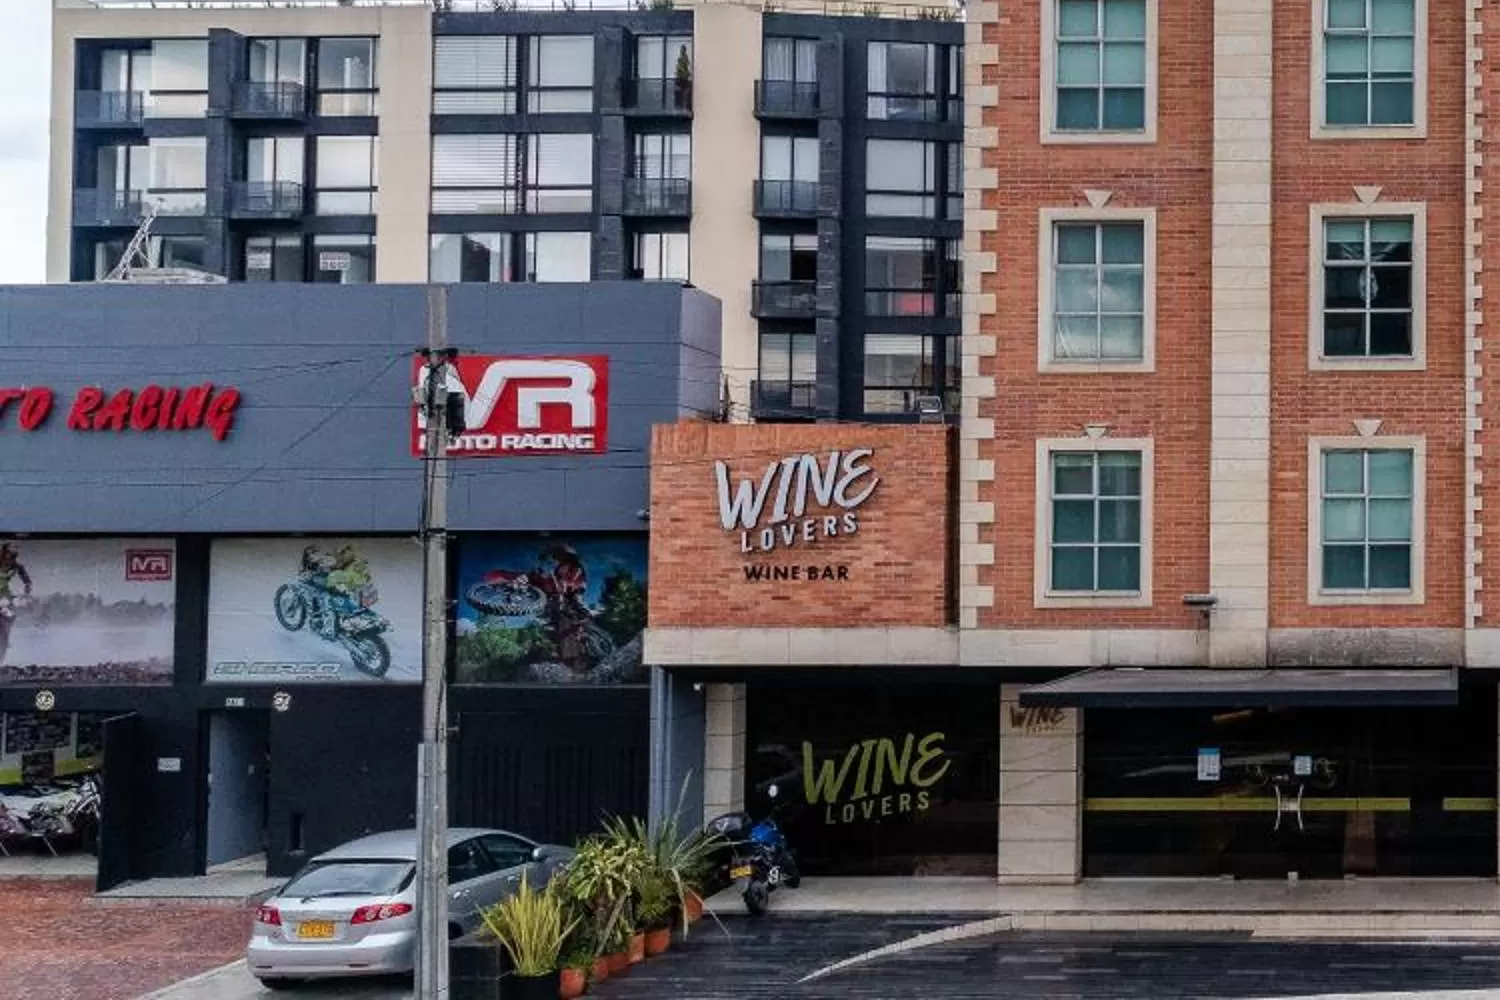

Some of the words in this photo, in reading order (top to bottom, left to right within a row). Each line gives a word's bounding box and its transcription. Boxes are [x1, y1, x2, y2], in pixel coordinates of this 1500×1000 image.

[67, 382, 241, 441] RACING
[501, 433, 595, 450] RACING
[715, 448, 881, 531] WINE
[741, 512, 858, 553] LOVERS
[744, 564, 800, 581] WINE
[807, 565, 849, 581] BAR
[802, 731, 951, 805] WINE
[825, 791, 930, 825] LOVERS
